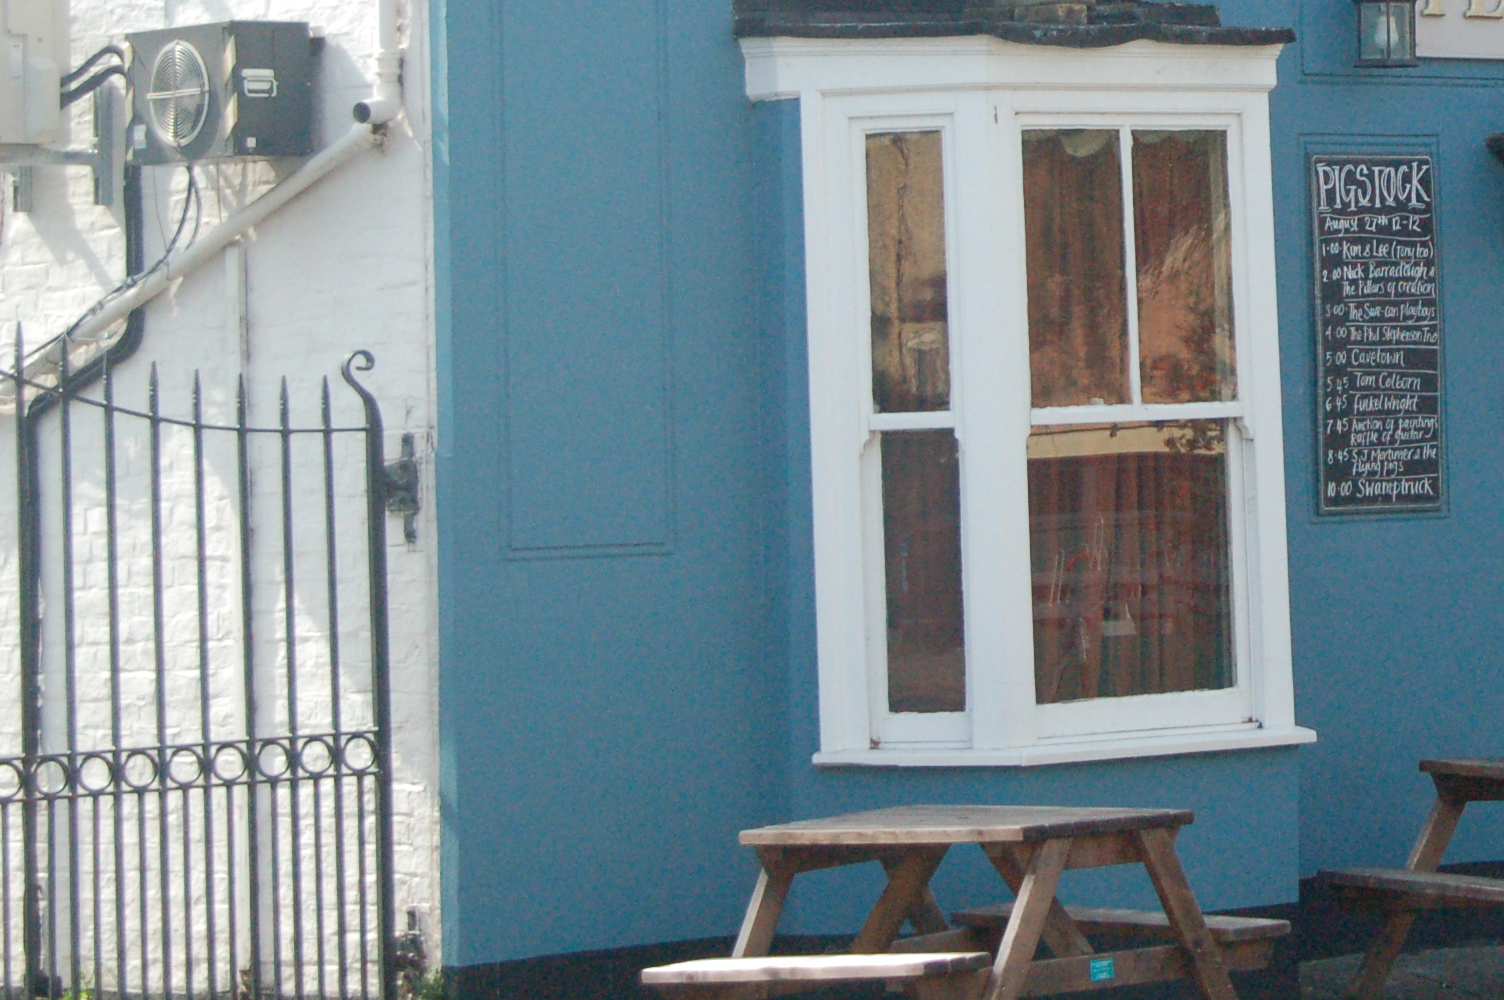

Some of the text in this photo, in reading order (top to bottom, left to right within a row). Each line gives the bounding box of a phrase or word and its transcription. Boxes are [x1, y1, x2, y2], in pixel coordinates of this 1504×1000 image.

[1316, 162, 1431, 212] PIGSTOCK
[1325, 216, 1358, 237] August
[1373, 239, 1389, 257] Lee
[1352, 348, 1405, 367] Cavetown
